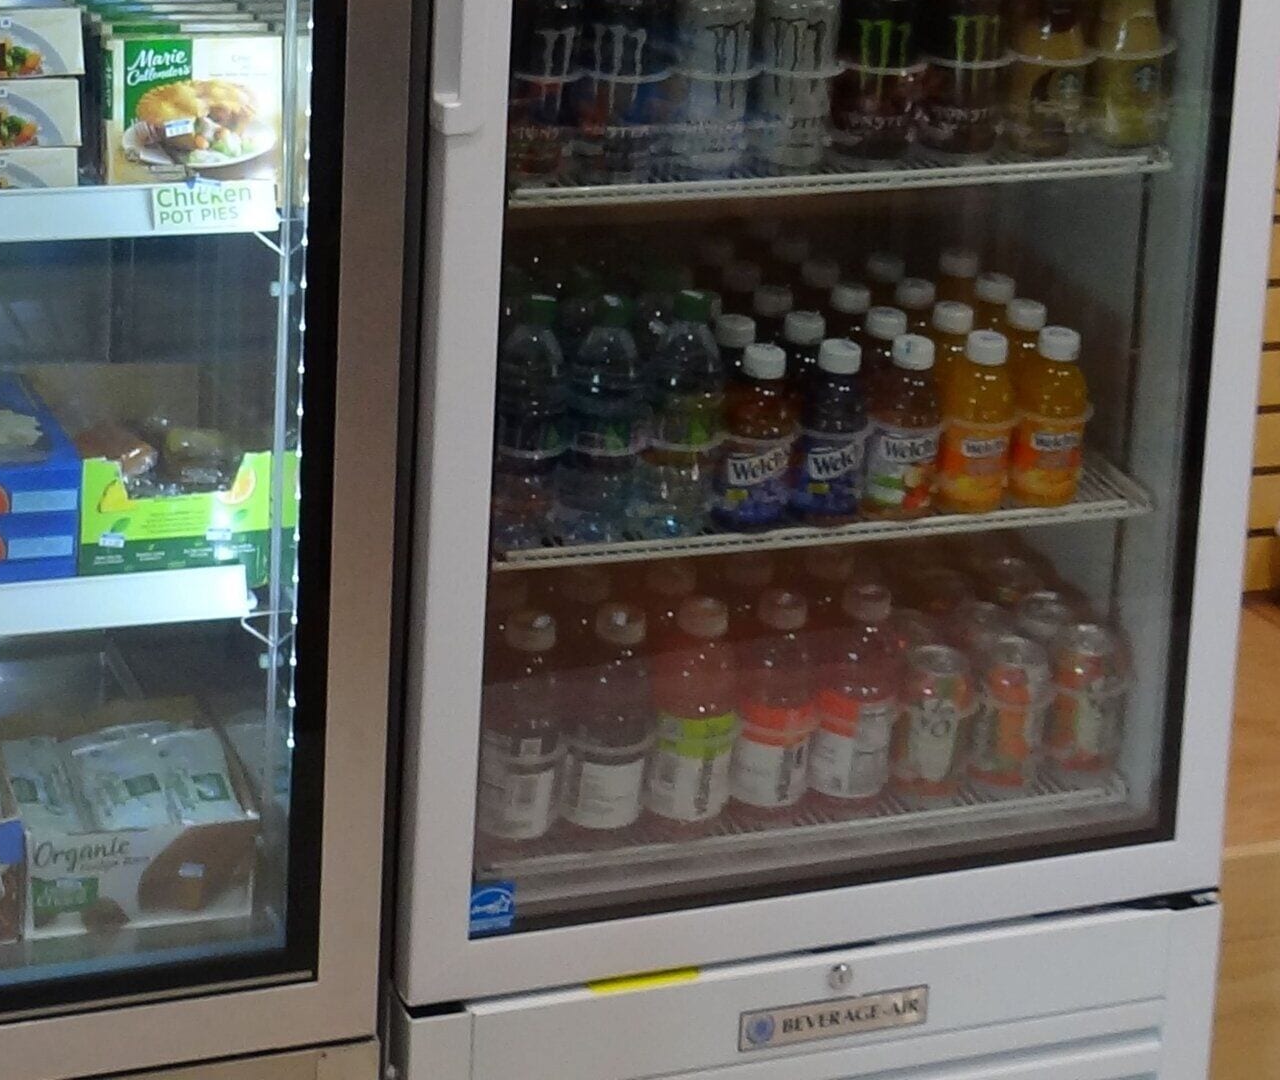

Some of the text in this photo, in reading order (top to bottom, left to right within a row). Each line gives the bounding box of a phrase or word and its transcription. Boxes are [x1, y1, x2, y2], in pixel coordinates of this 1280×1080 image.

[126, 48, 188, 71] Marie
[157, 184, 252, 208] Chicken
[160, 206, 239, 225] POT PIES
[34, 837, 130, 873] Organic
[781, 998, 920, 1033] BEVERAGE-AIR
